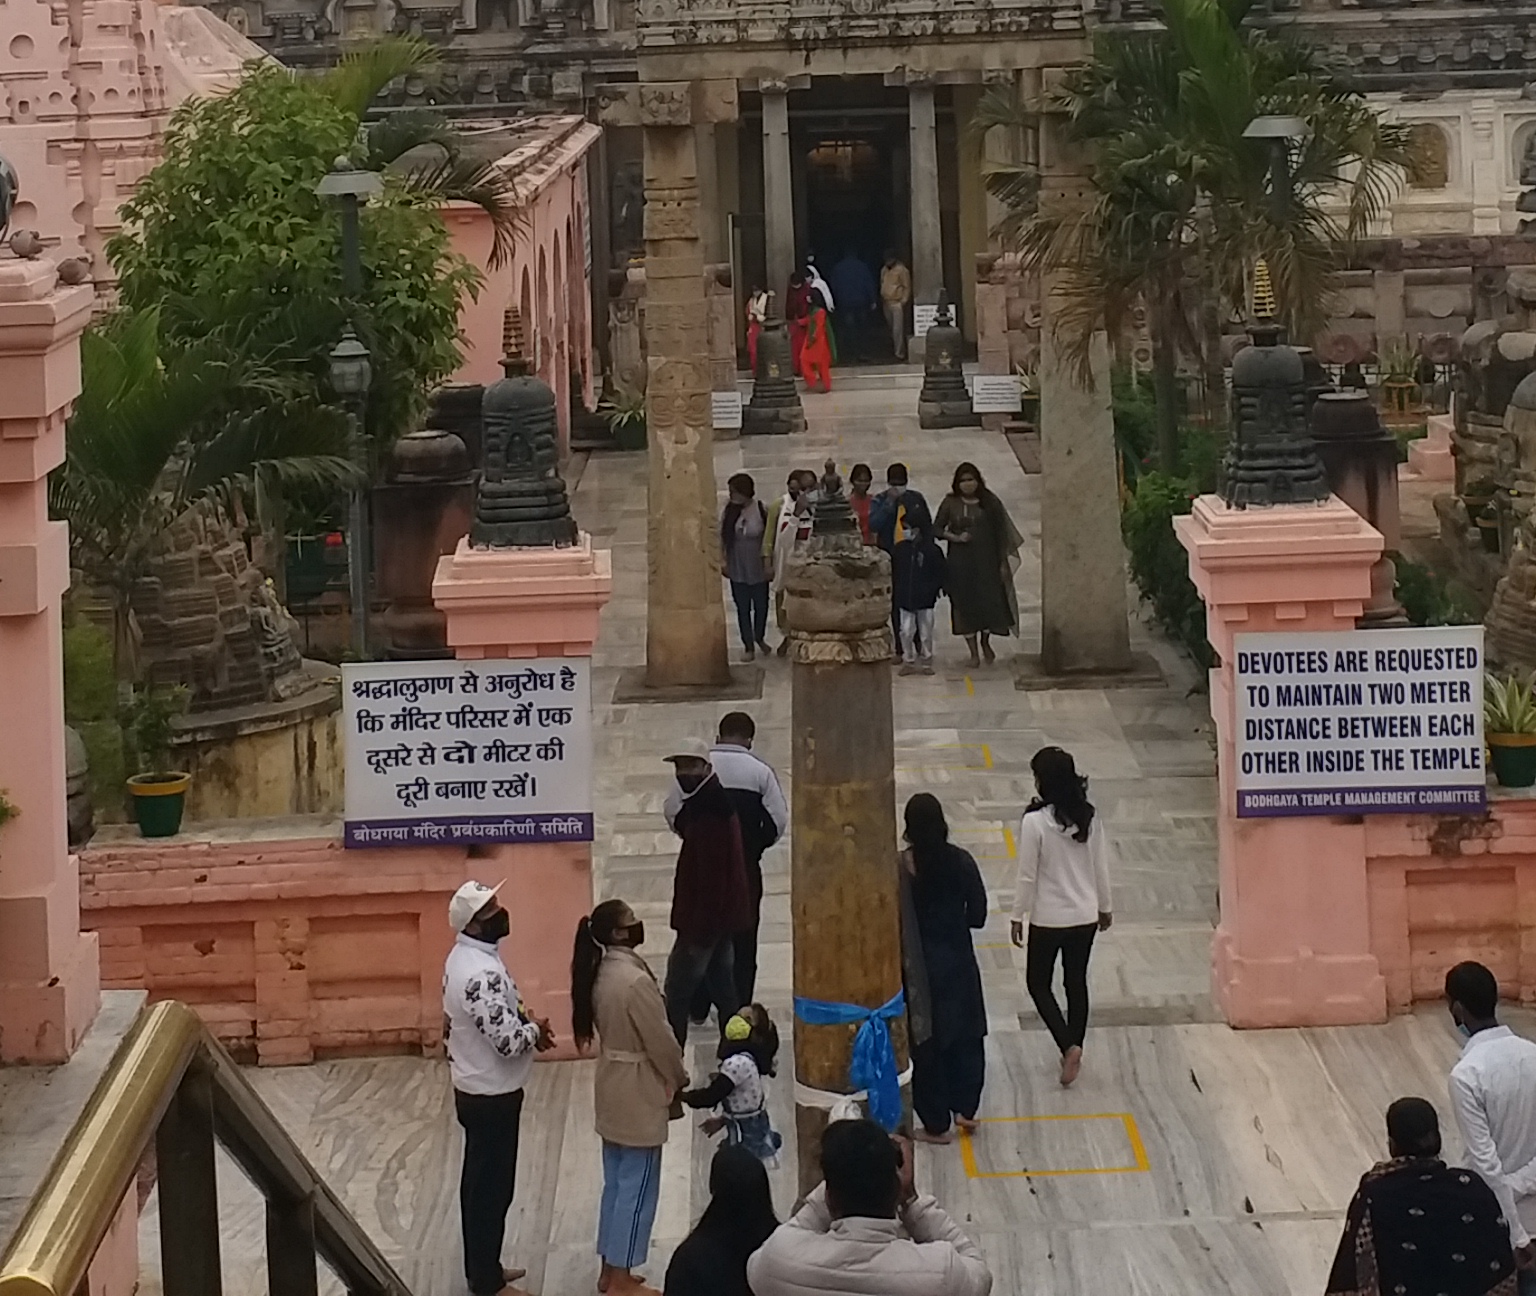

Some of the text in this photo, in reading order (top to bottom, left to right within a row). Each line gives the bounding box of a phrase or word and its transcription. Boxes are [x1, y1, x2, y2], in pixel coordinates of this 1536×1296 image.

[1238, 647, 1478, 674] DEVOTEES ARE REQUESTED
[352, 665, 577, 702] श्रद्धालुगण से अनुरोध है
[1247, 680, 1471, 707] TO MAINTAIN TWO METER
[356, 702, 574, 734] कि मंदिर परिसर में एक
[1245, 714, 1475, 741] DISTANCE BETWEEN EACH
[366, 736, 564, 775] दूसरे से दो मीटर की
[1241, 747, 1481, 774] OTHER INSIDE THE TEMPLE
[396, 777, 429, 808] दूरी
[434, 780, 487, 800] बनाए
[1244, 790, 1481, 808] BODHGAYA TEMPLE MANAGEMENT COMMITTEE
[352, 824, 409, 841] बोधगया
[412, 822, 447, 840] मंदिर
[538, 817, 583, 835] समिति
